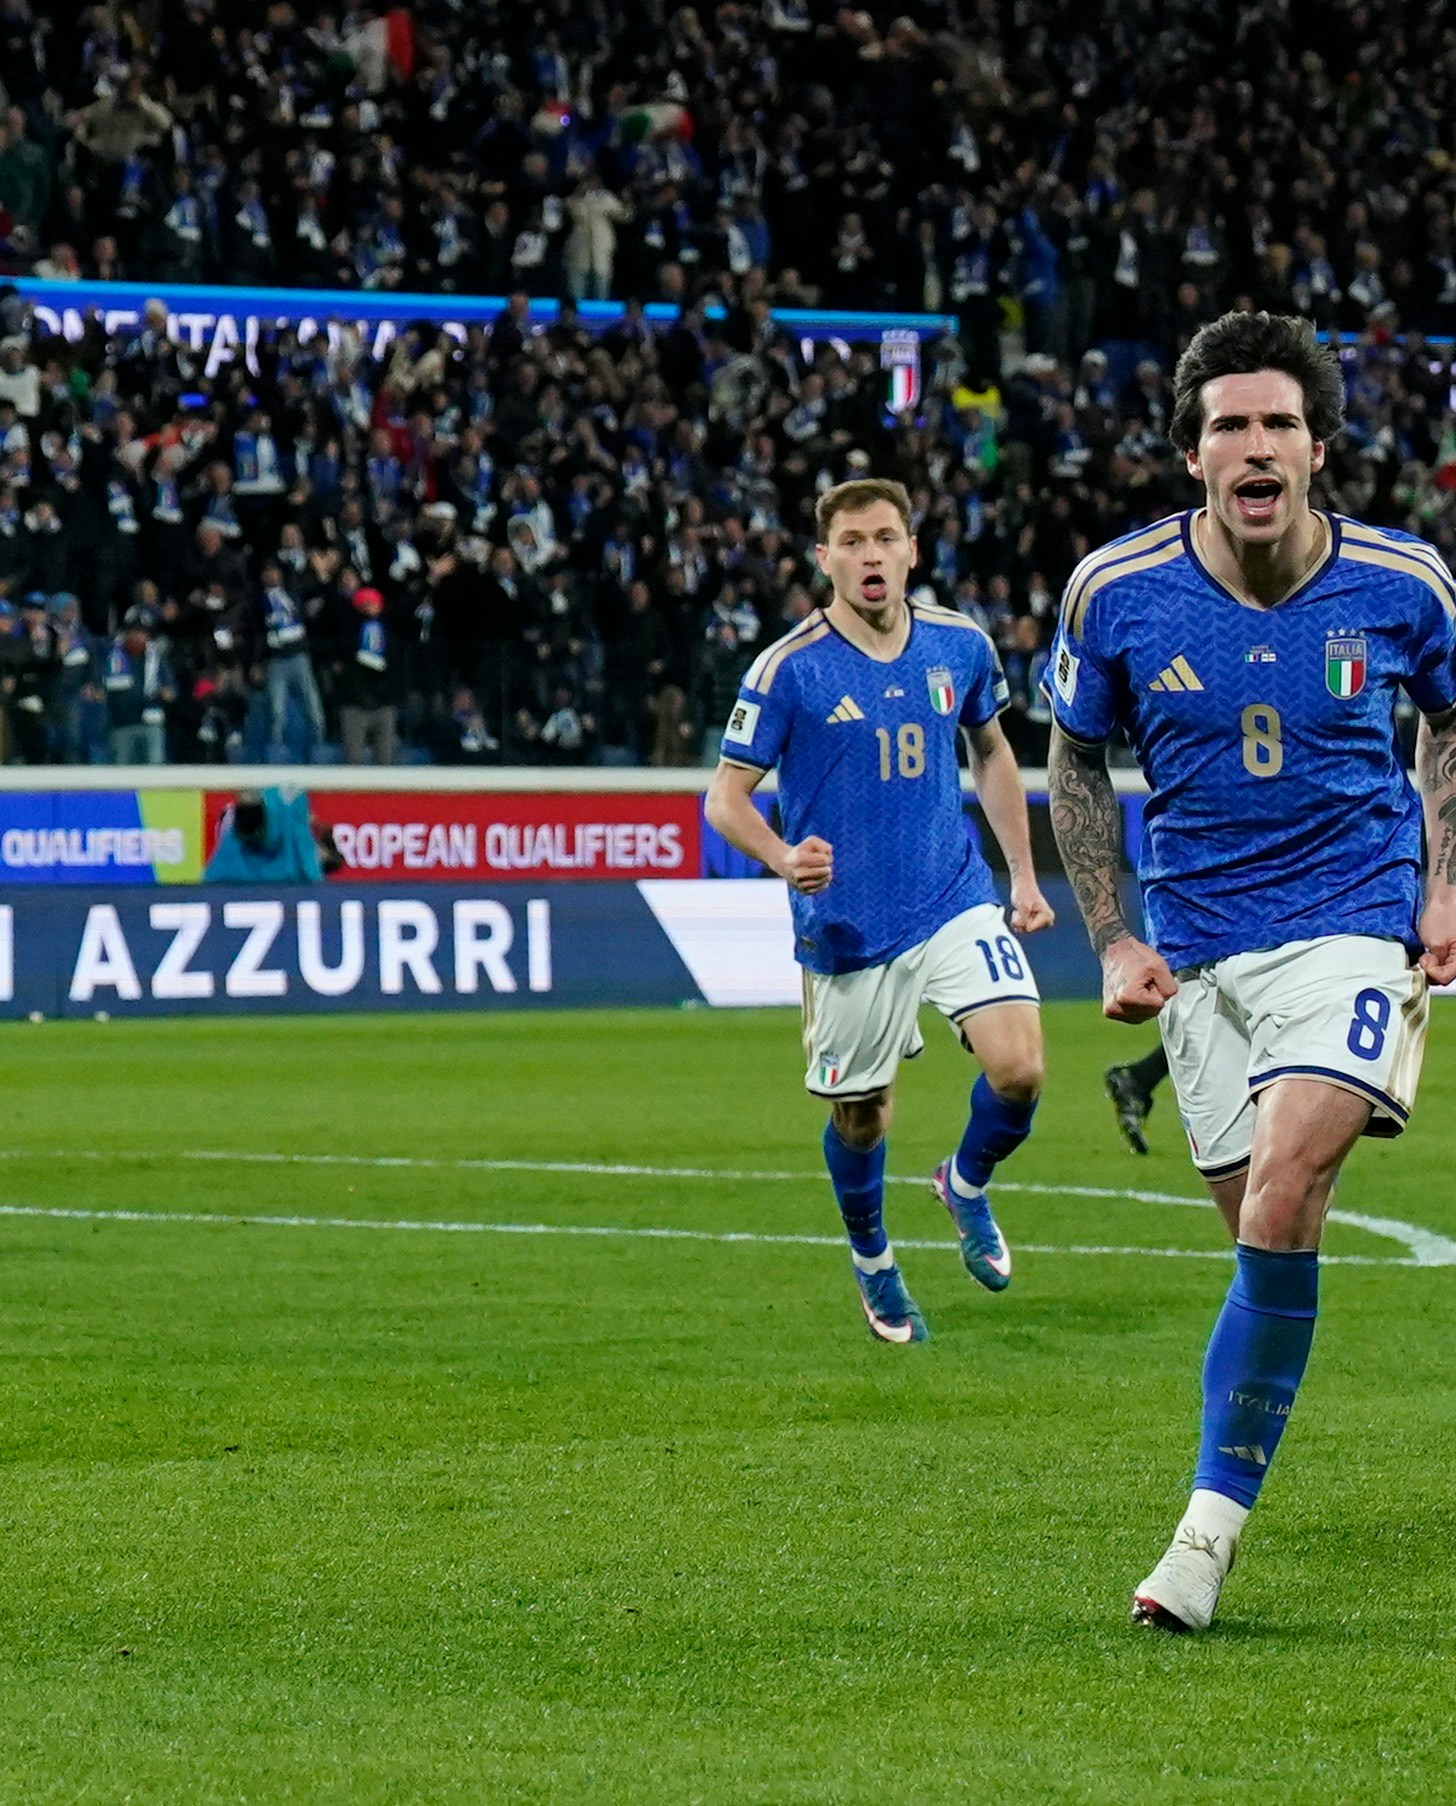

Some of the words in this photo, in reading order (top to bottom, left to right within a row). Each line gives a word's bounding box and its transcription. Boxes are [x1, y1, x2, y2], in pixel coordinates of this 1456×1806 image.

[1328, 643, 1364, 657] ITALIA
[875, 722, 926, 782] 18
[1241, 703, 1283, 778] 8
[1, 828, 184, 866] QUALIFIERS
[485, 823, 684, 869] QUALIFIERS
[68, 900, 552, 1001] AZZURRI
[976, 935, 1024, 982] 18
[1347, 988, 1391, 1061] 8
